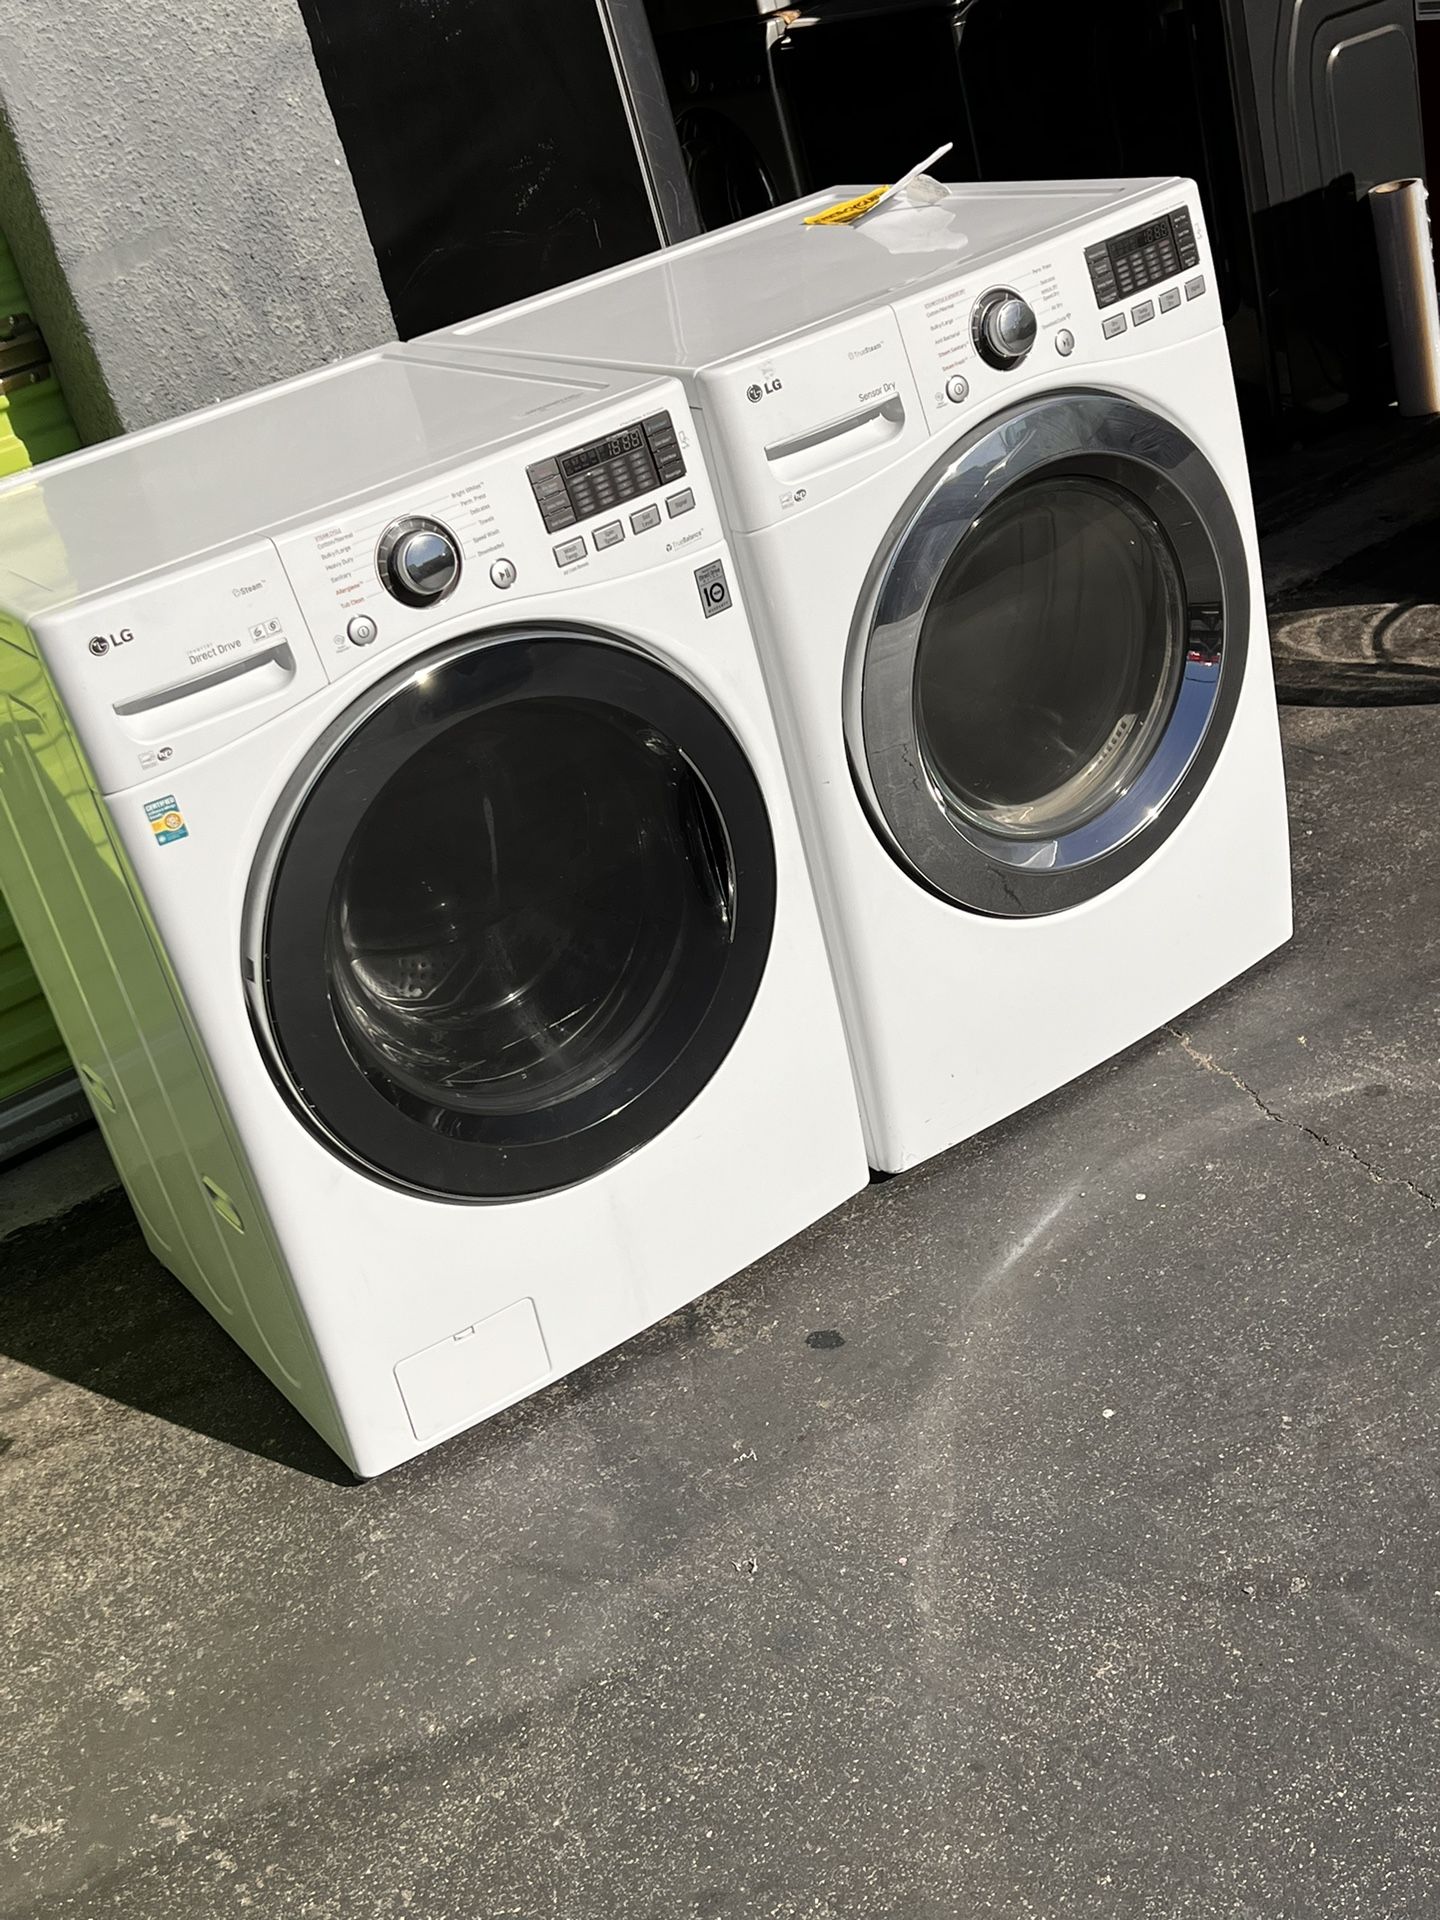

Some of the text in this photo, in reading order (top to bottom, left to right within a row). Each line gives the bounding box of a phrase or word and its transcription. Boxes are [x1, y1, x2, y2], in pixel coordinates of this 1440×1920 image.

[763, 378, 783, 395] LG
[858, 381, 896, 402] Sensor Dry
[109, 628, 135, 647] LG
[188, 646, 218, 665] Direct
[217, 639, 243, 657] Drive
